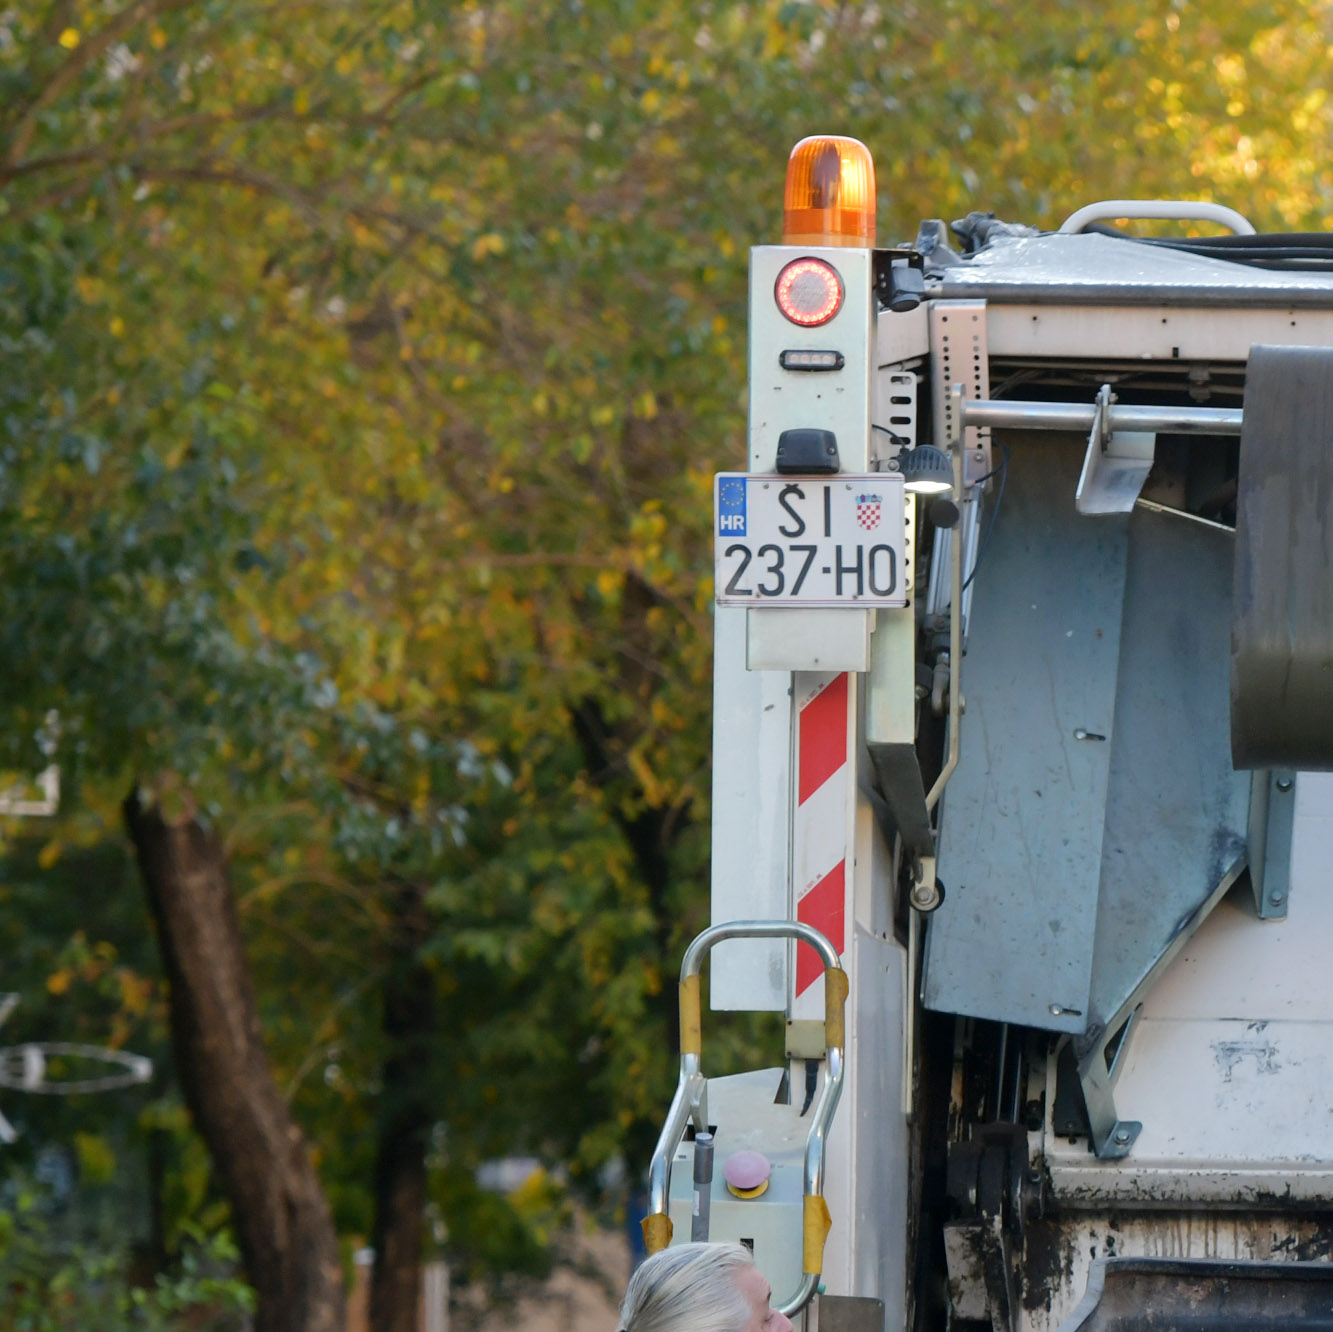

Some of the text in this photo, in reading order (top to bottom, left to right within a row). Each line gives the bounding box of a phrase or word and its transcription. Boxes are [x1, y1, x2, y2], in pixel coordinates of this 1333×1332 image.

[720, 515, 744, 530] HR
[778, 483, 832, 538] ŠI
[724, 543, 897, 597] 237-HO
